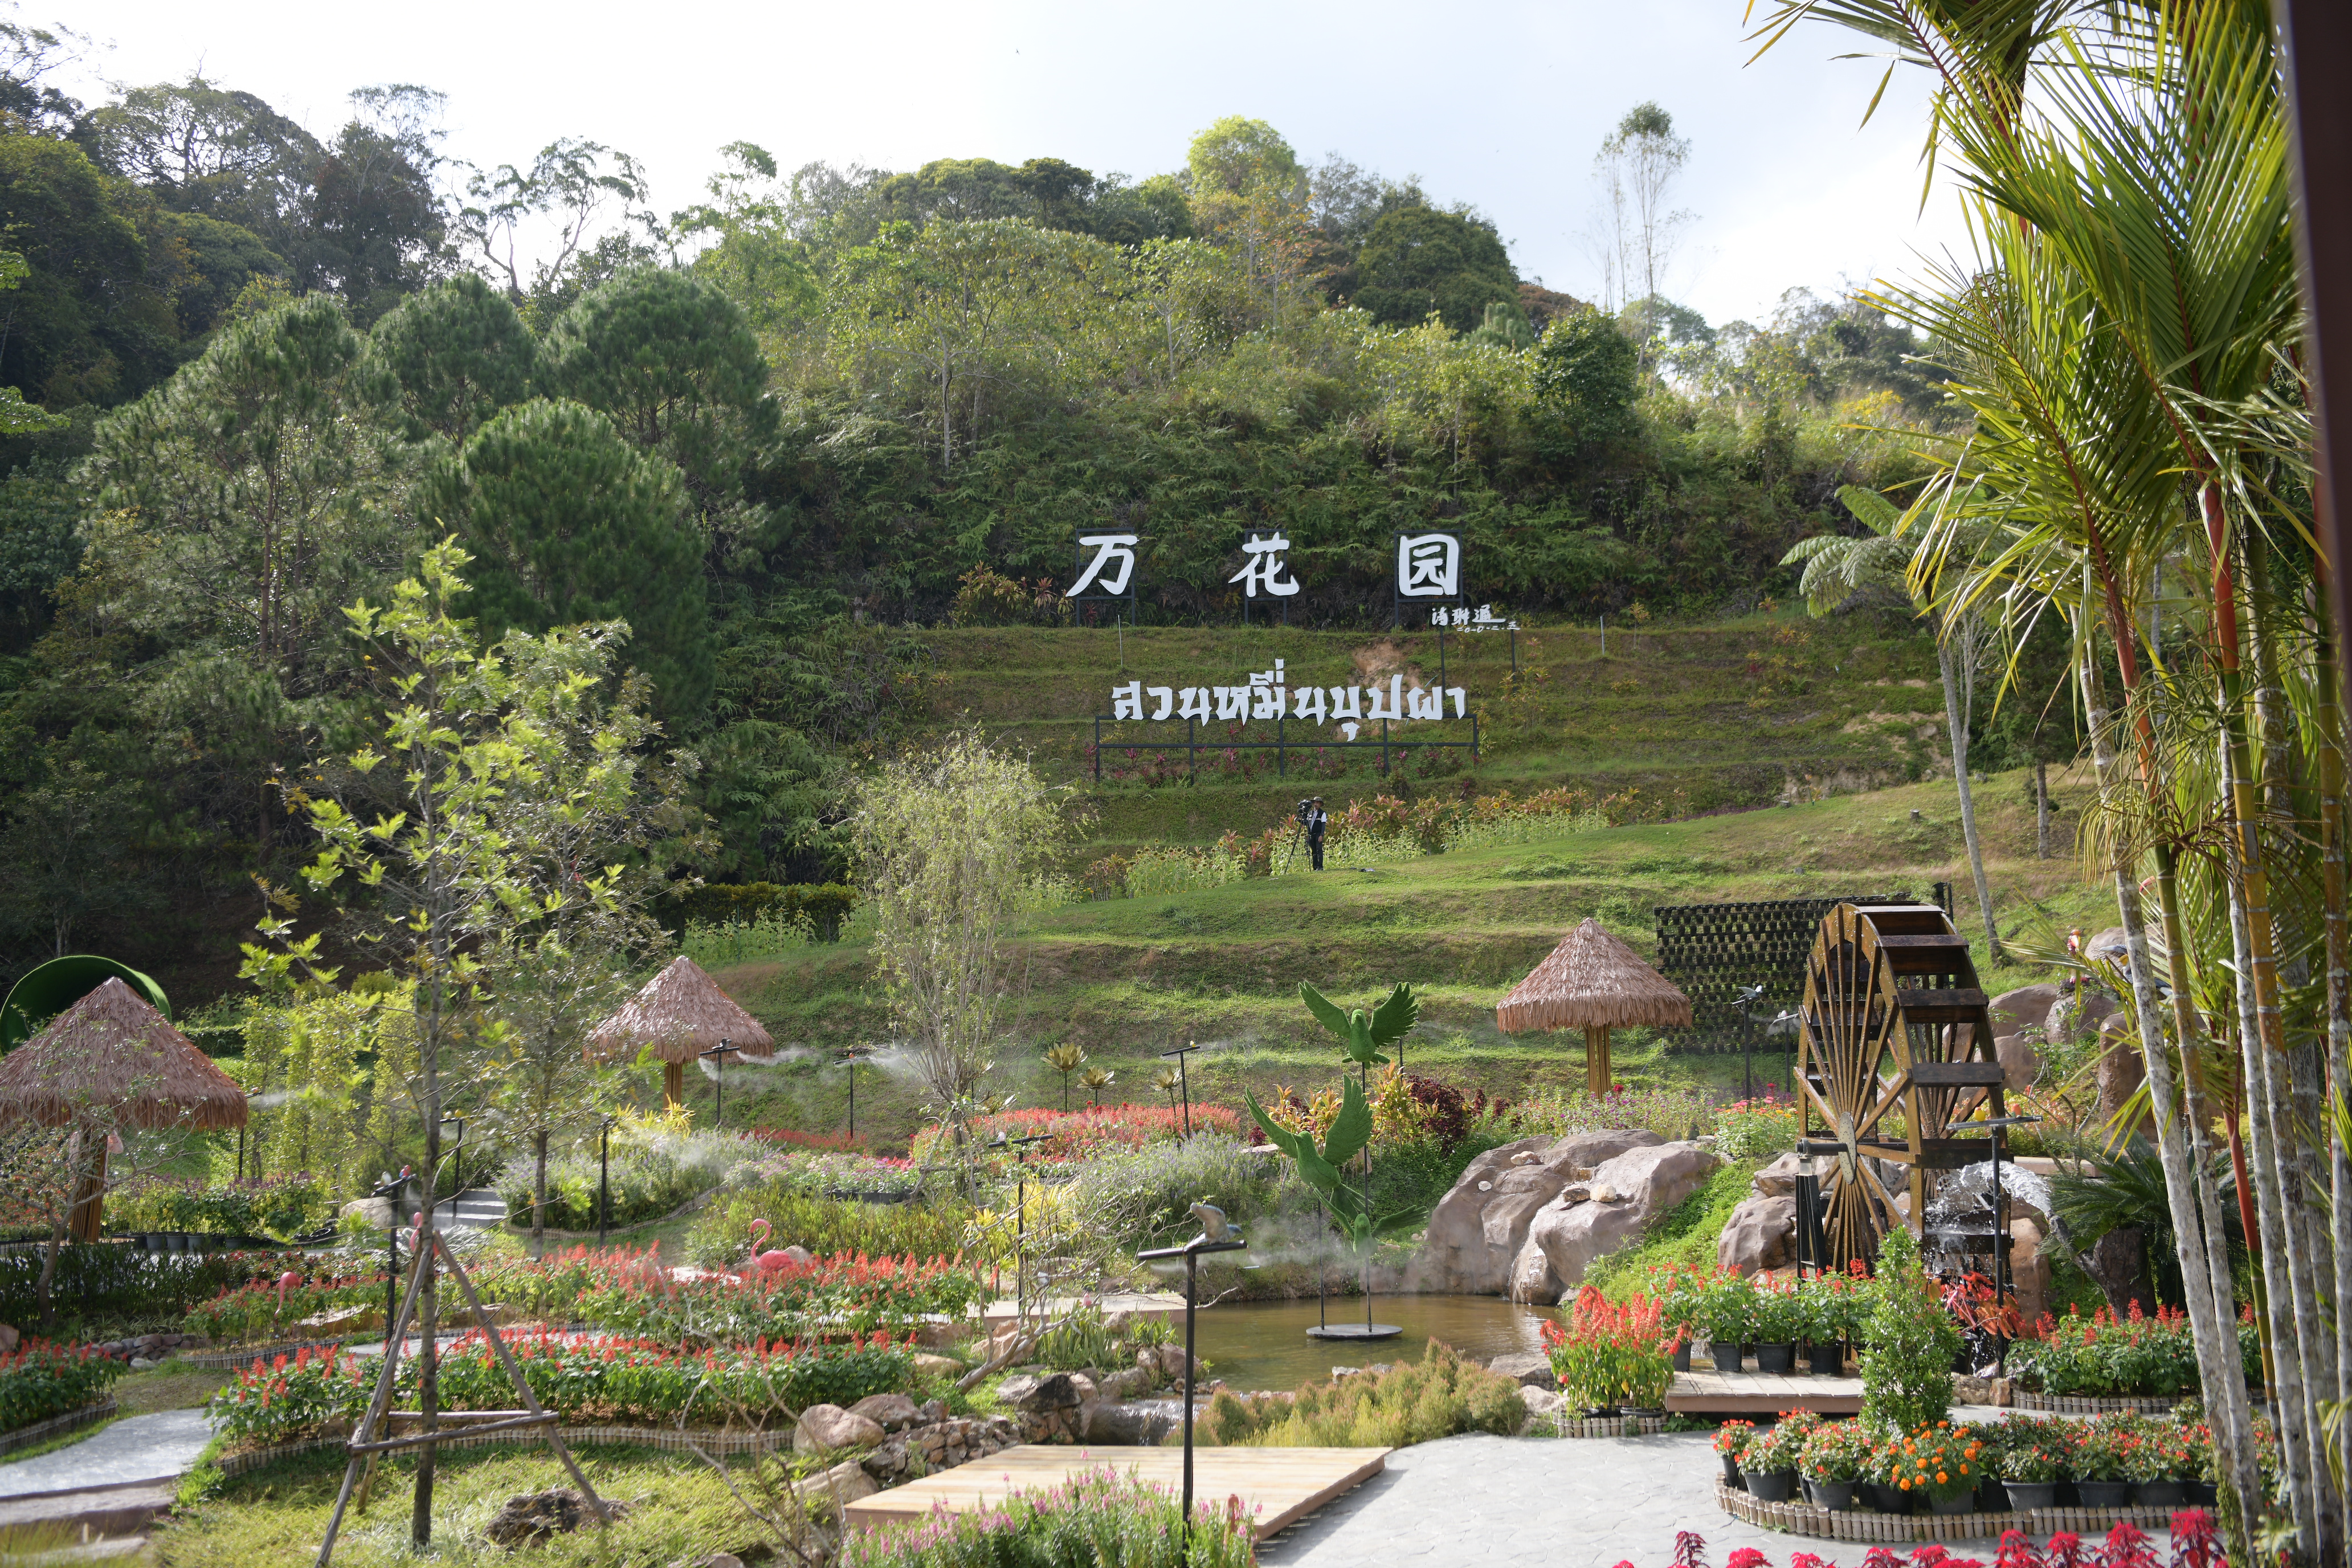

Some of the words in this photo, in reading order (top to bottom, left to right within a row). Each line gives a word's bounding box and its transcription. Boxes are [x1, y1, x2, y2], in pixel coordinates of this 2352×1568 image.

[1066, 532, 1459, 597] 万花园
[1112, 659, 1465, 742] สวนหมื่นบุปผา
